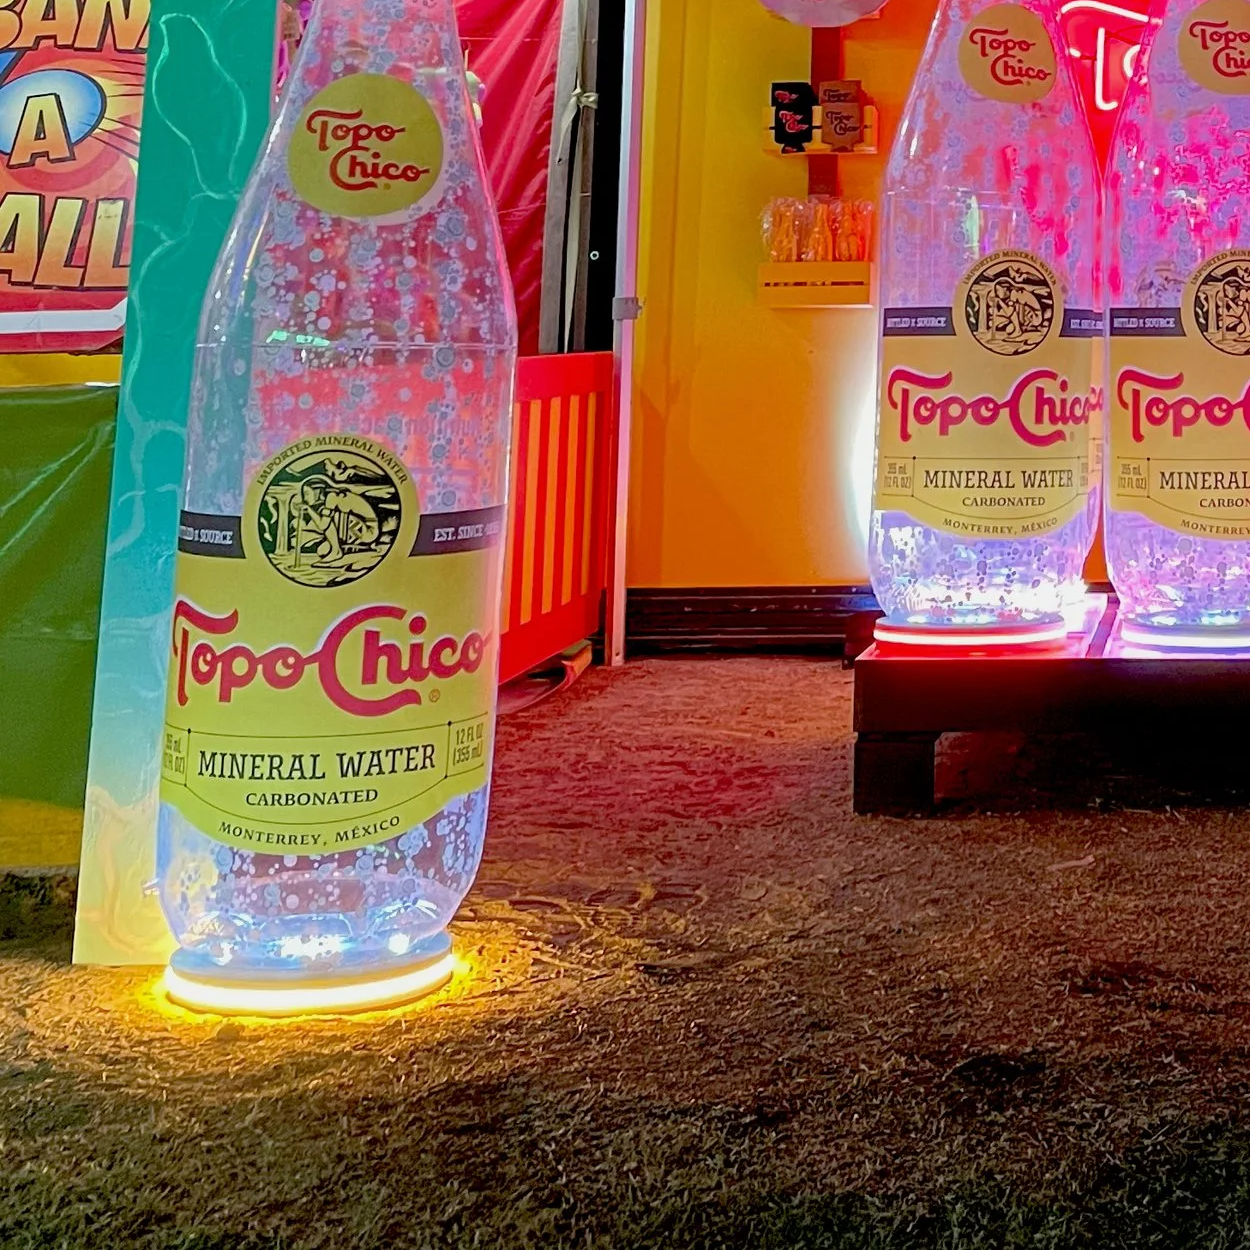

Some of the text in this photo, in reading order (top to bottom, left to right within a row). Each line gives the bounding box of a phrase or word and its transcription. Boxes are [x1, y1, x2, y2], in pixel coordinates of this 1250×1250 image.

[969, 28, 1036, 57] Topo
[991, 53, 1052, 85] Chico
[7, 92, 75, 168] A
[306, 108, 406, 151] Topo
[330, 146, 430, 190] Chico
[887, 369, 1002, 442] Topo
[1117, 368, 1236, 443] Topo
[257, 437, 408, 485] IMPORTED MINERAL WATER
[924, 470, 1015, 490] MINERAL
[1022, 469, 1073, 488] WATER
[962, 496, 1046, 507] CARBONATED
[200, 529, 233, 545] SOURCE
[434, 527, 456, 542] EST.
[458, 524, 484, 540] SINCE
[942, 516, 1058, 535] MONTERREY, MÉXICO
[172, 600, 494, 717] Topo Chico
[198, 750, 326, 781] MINERAL
[336, 743, 437, 778] WATER
[246, 788, 379, 807] CARBONATED
[219, 815, 401, 847] MONTERREY, MÉXICO
